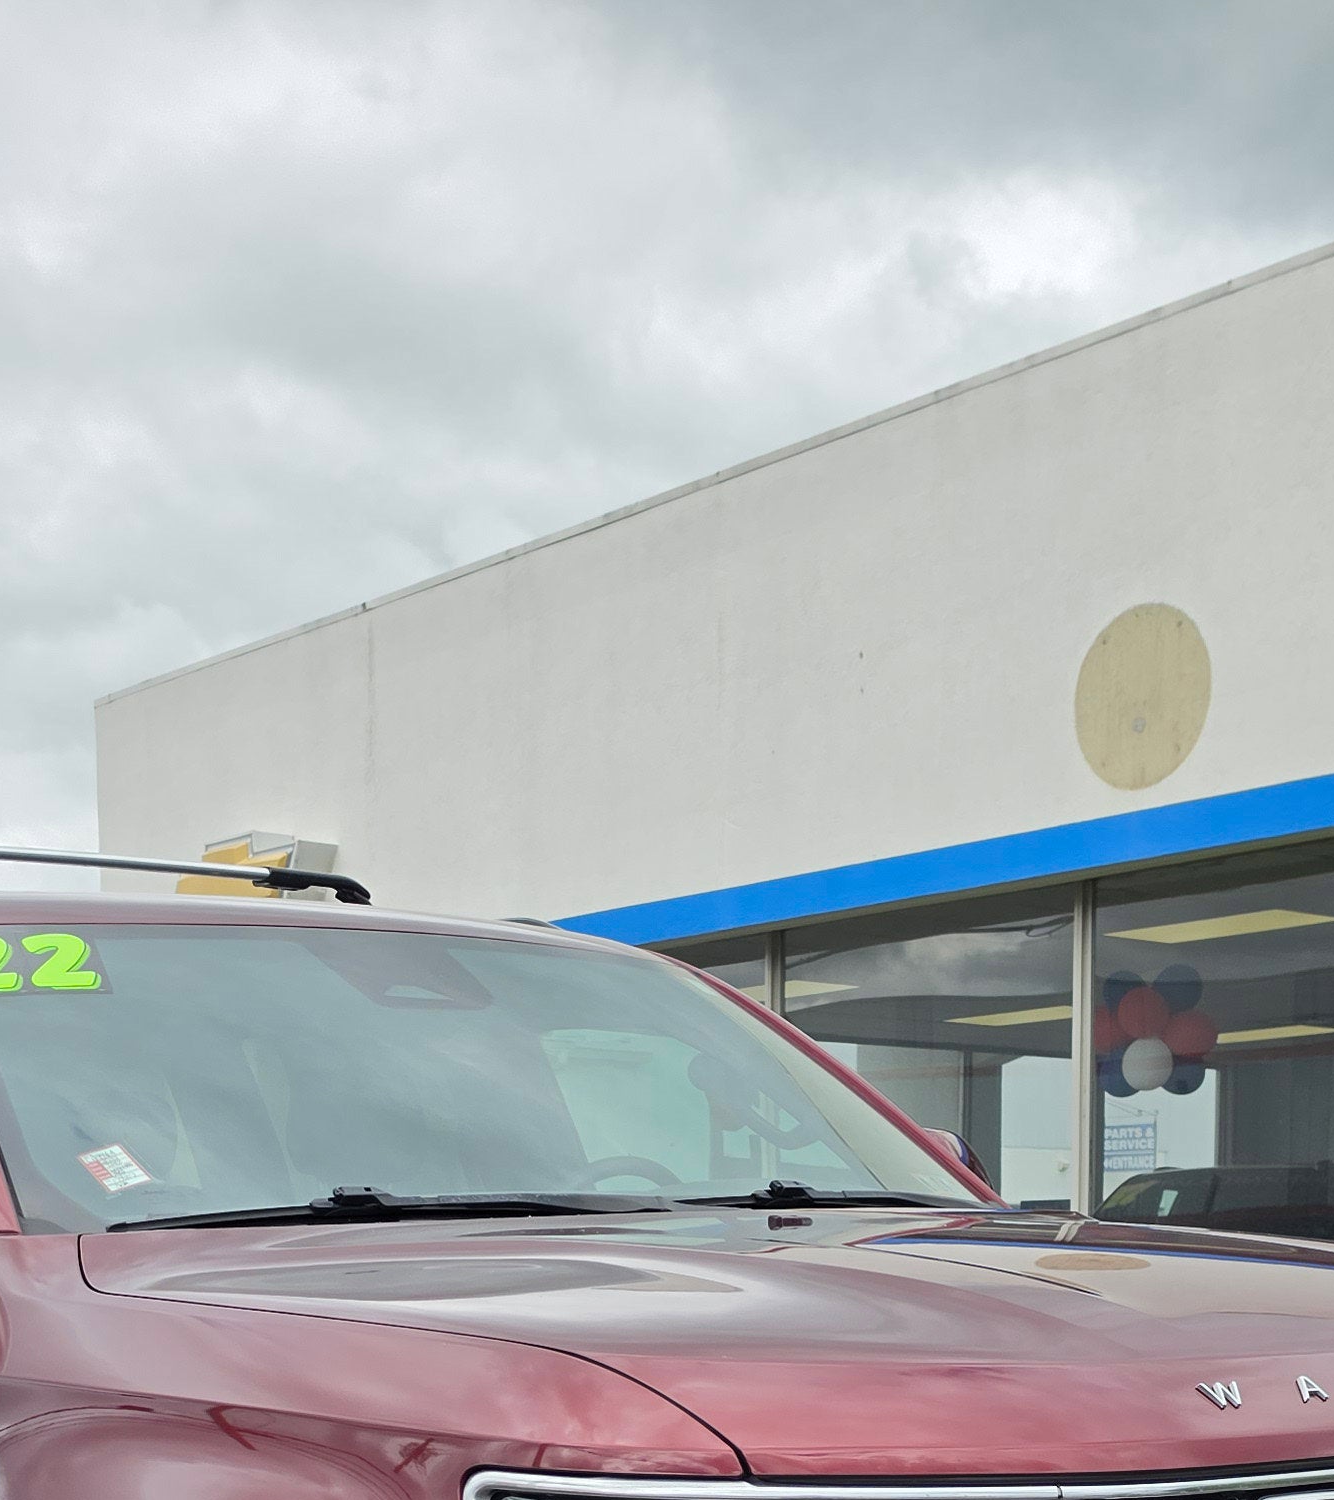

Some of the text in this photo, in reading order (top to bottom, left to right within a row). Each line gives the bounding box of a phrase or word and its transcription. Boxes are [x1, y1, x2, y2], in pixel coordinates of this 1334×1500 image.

[1104, 1126, 1154, 1139] PARTS &
[1104, 1139, 1155, 1150] SERVICE
[1112, 1155, 1154, 1170] ENTRANCE
